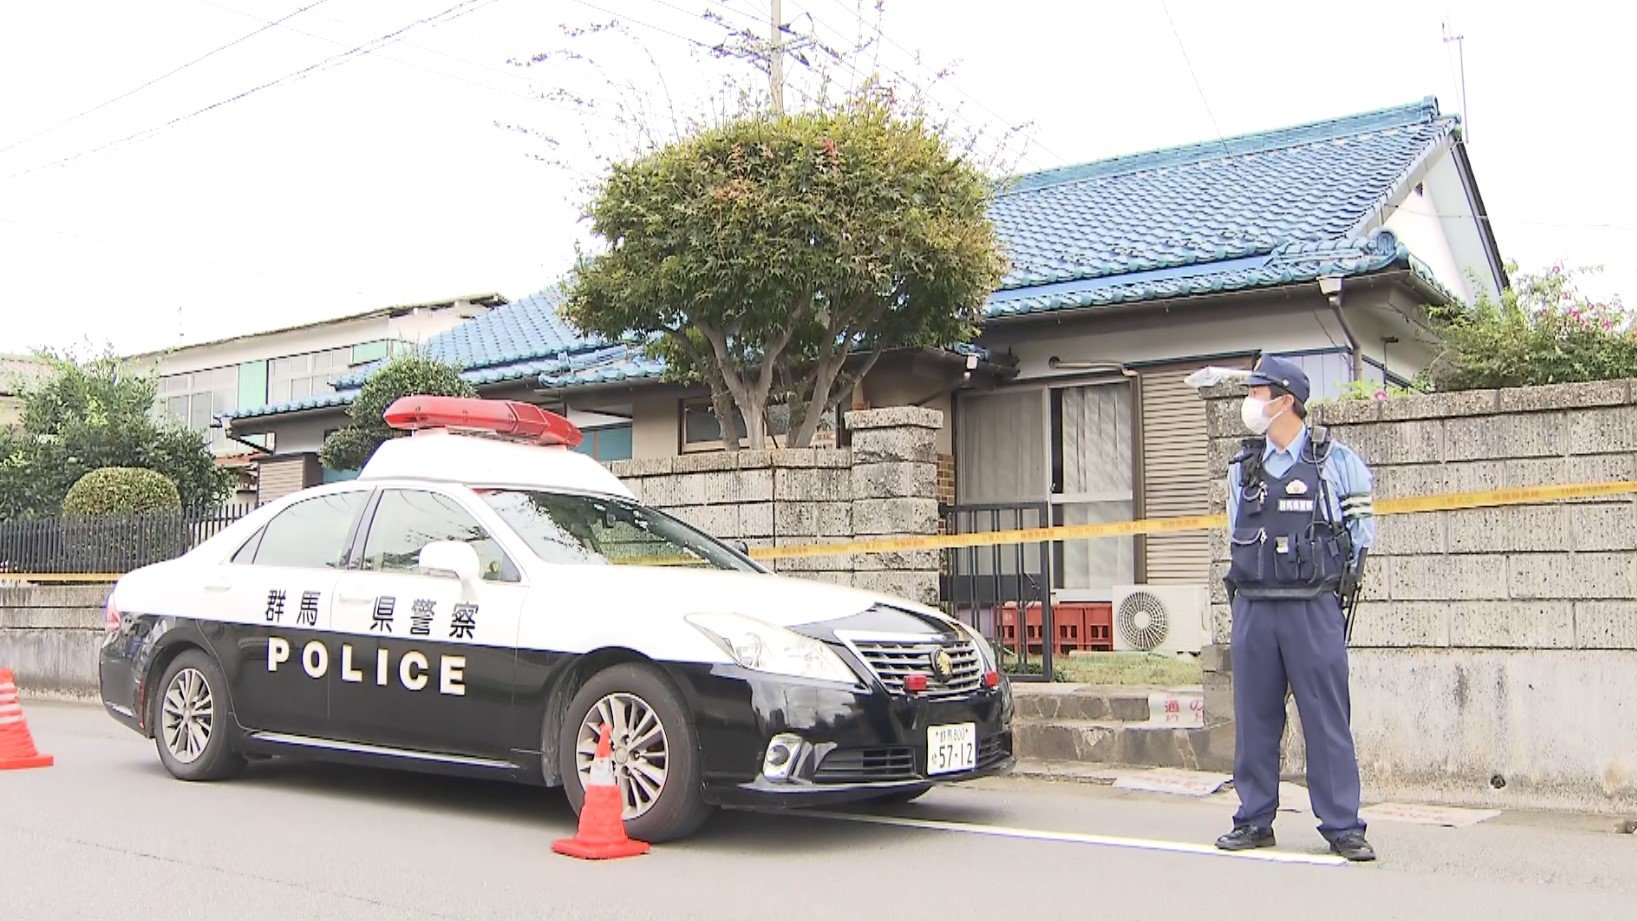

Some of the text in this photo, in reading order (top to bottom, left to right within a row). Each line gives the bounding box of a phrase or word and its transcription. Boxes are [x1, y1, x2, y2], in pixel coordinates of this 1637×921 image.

[265, 588, 479, 639] 群馬県警察
[267, 636, 466, 695] POLICE
